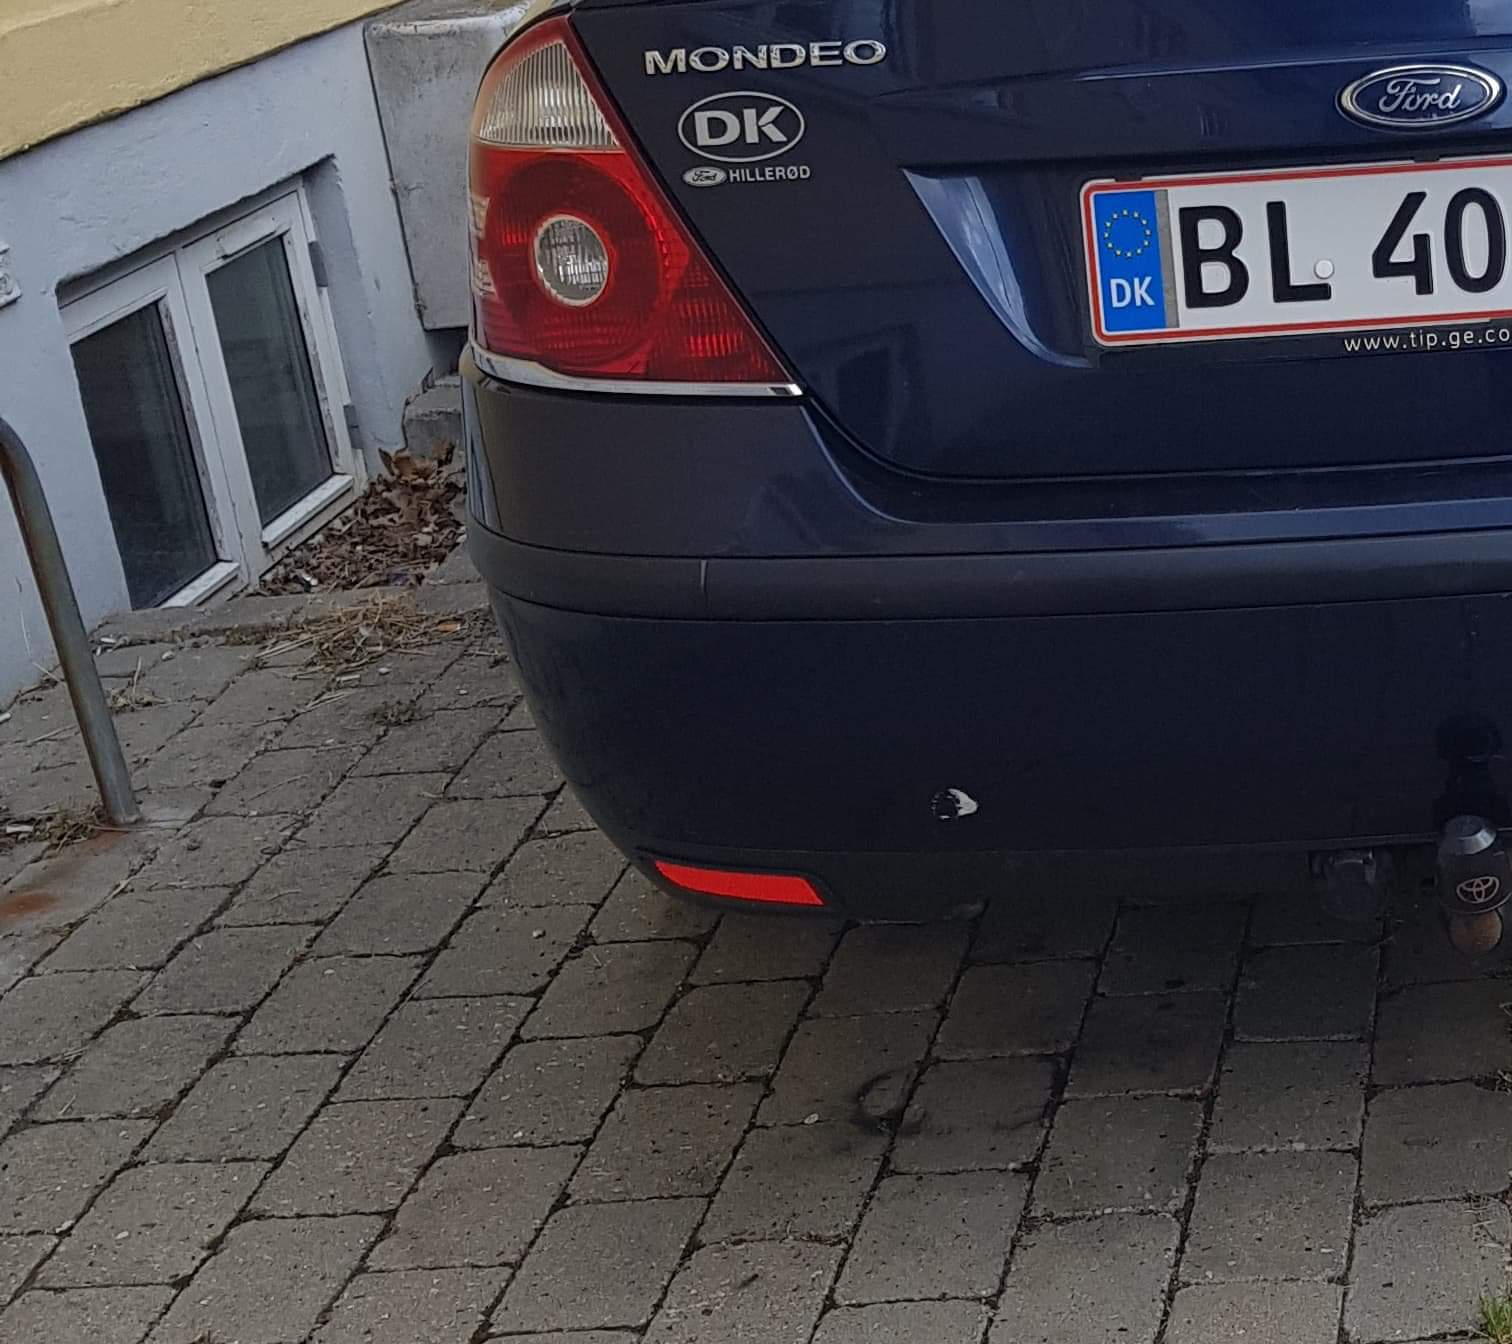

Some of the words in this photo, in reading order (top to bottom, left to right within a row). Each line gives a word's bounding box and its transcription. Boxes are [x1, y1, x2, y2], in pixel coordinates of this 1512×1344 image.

[644, 39, 887, 75] MONDEO
[1378, 77, 1463, 113] Ford
[694, 106, 788, 146] DK
[729, 165, 811, 183] HILLERØD
[1178, 200, 1332, 309] BL
[1372, 186, 1507, 296] 40
[1110, 276, 1156, 309] DK
